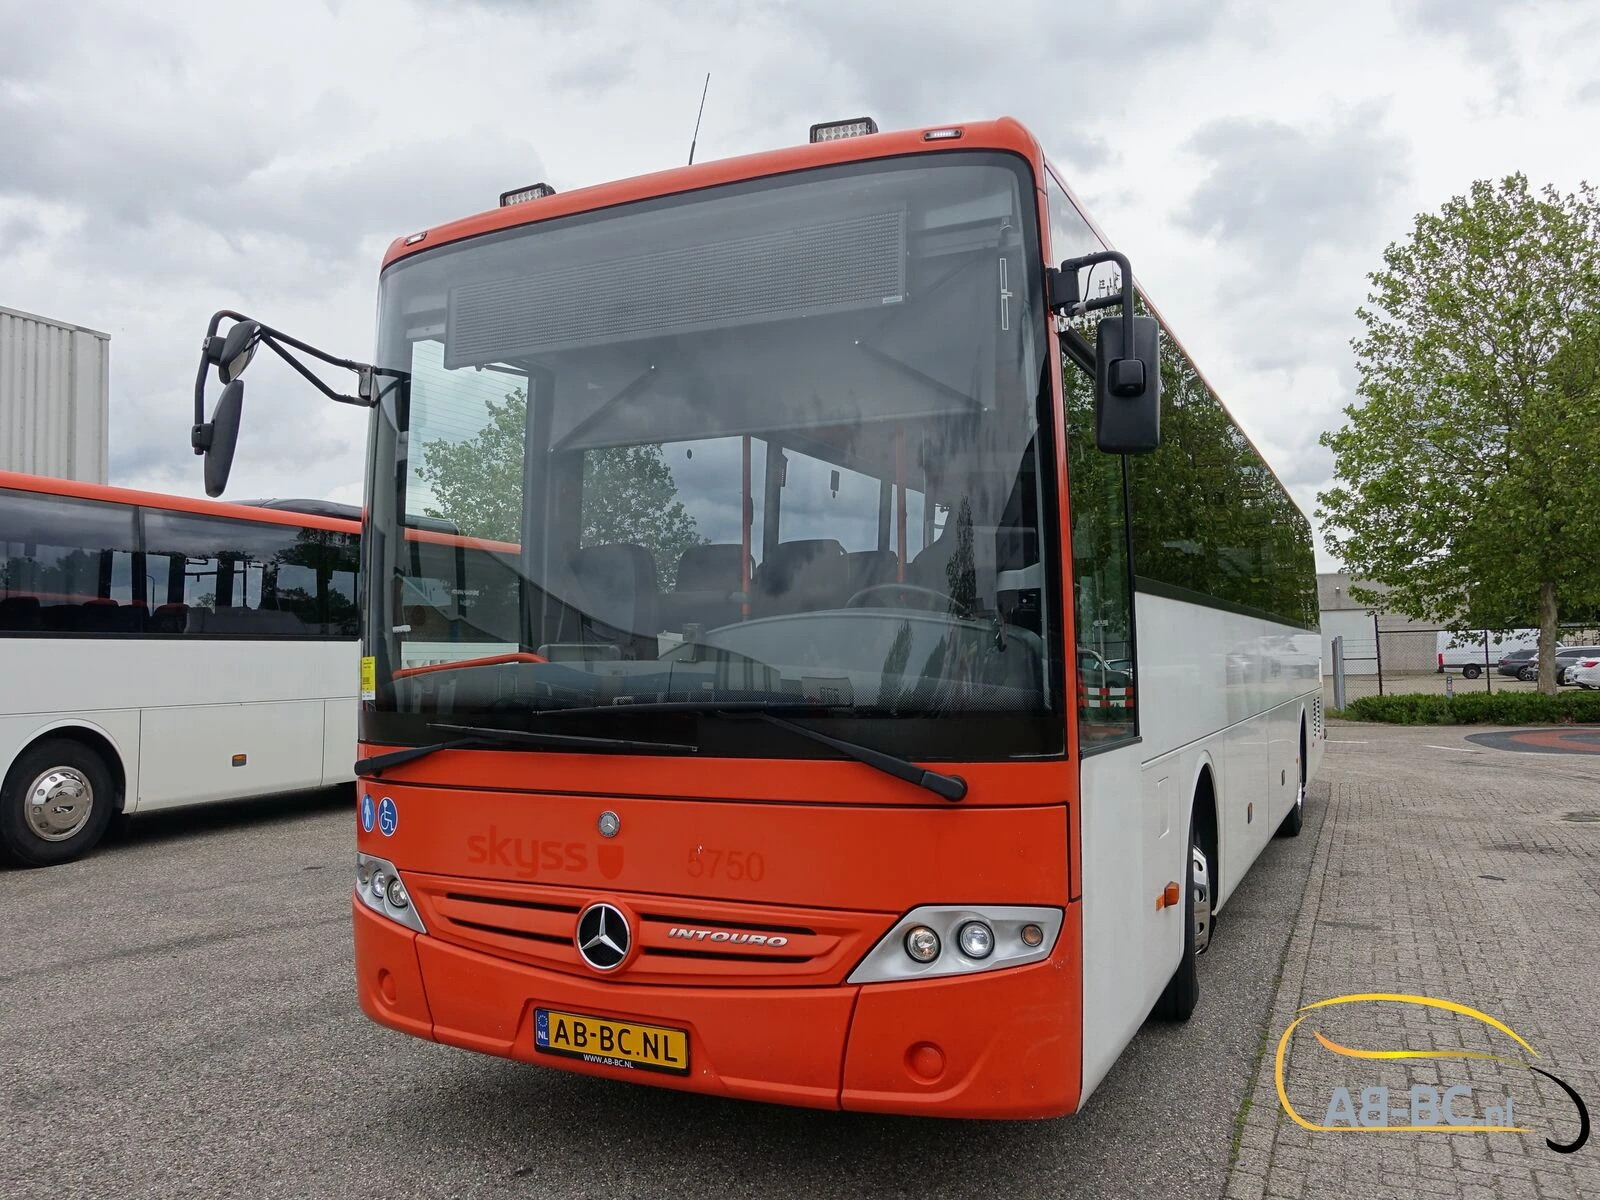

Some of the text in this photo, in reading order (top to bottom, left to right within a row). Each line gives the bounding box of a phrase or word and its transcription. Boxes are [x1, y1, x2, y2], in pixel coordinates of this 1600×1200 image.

[466, 825, 588, 878] skyss
[687, 847, 765, 883] 5750
[668, 927, 789, 948] INTOURO
[538, 1030, 548, 1041] NL
[554, 1019, 678, 1062] AB-BC.NL
[583, 1054, 634, 1069] WWW.AB-BC.NL
